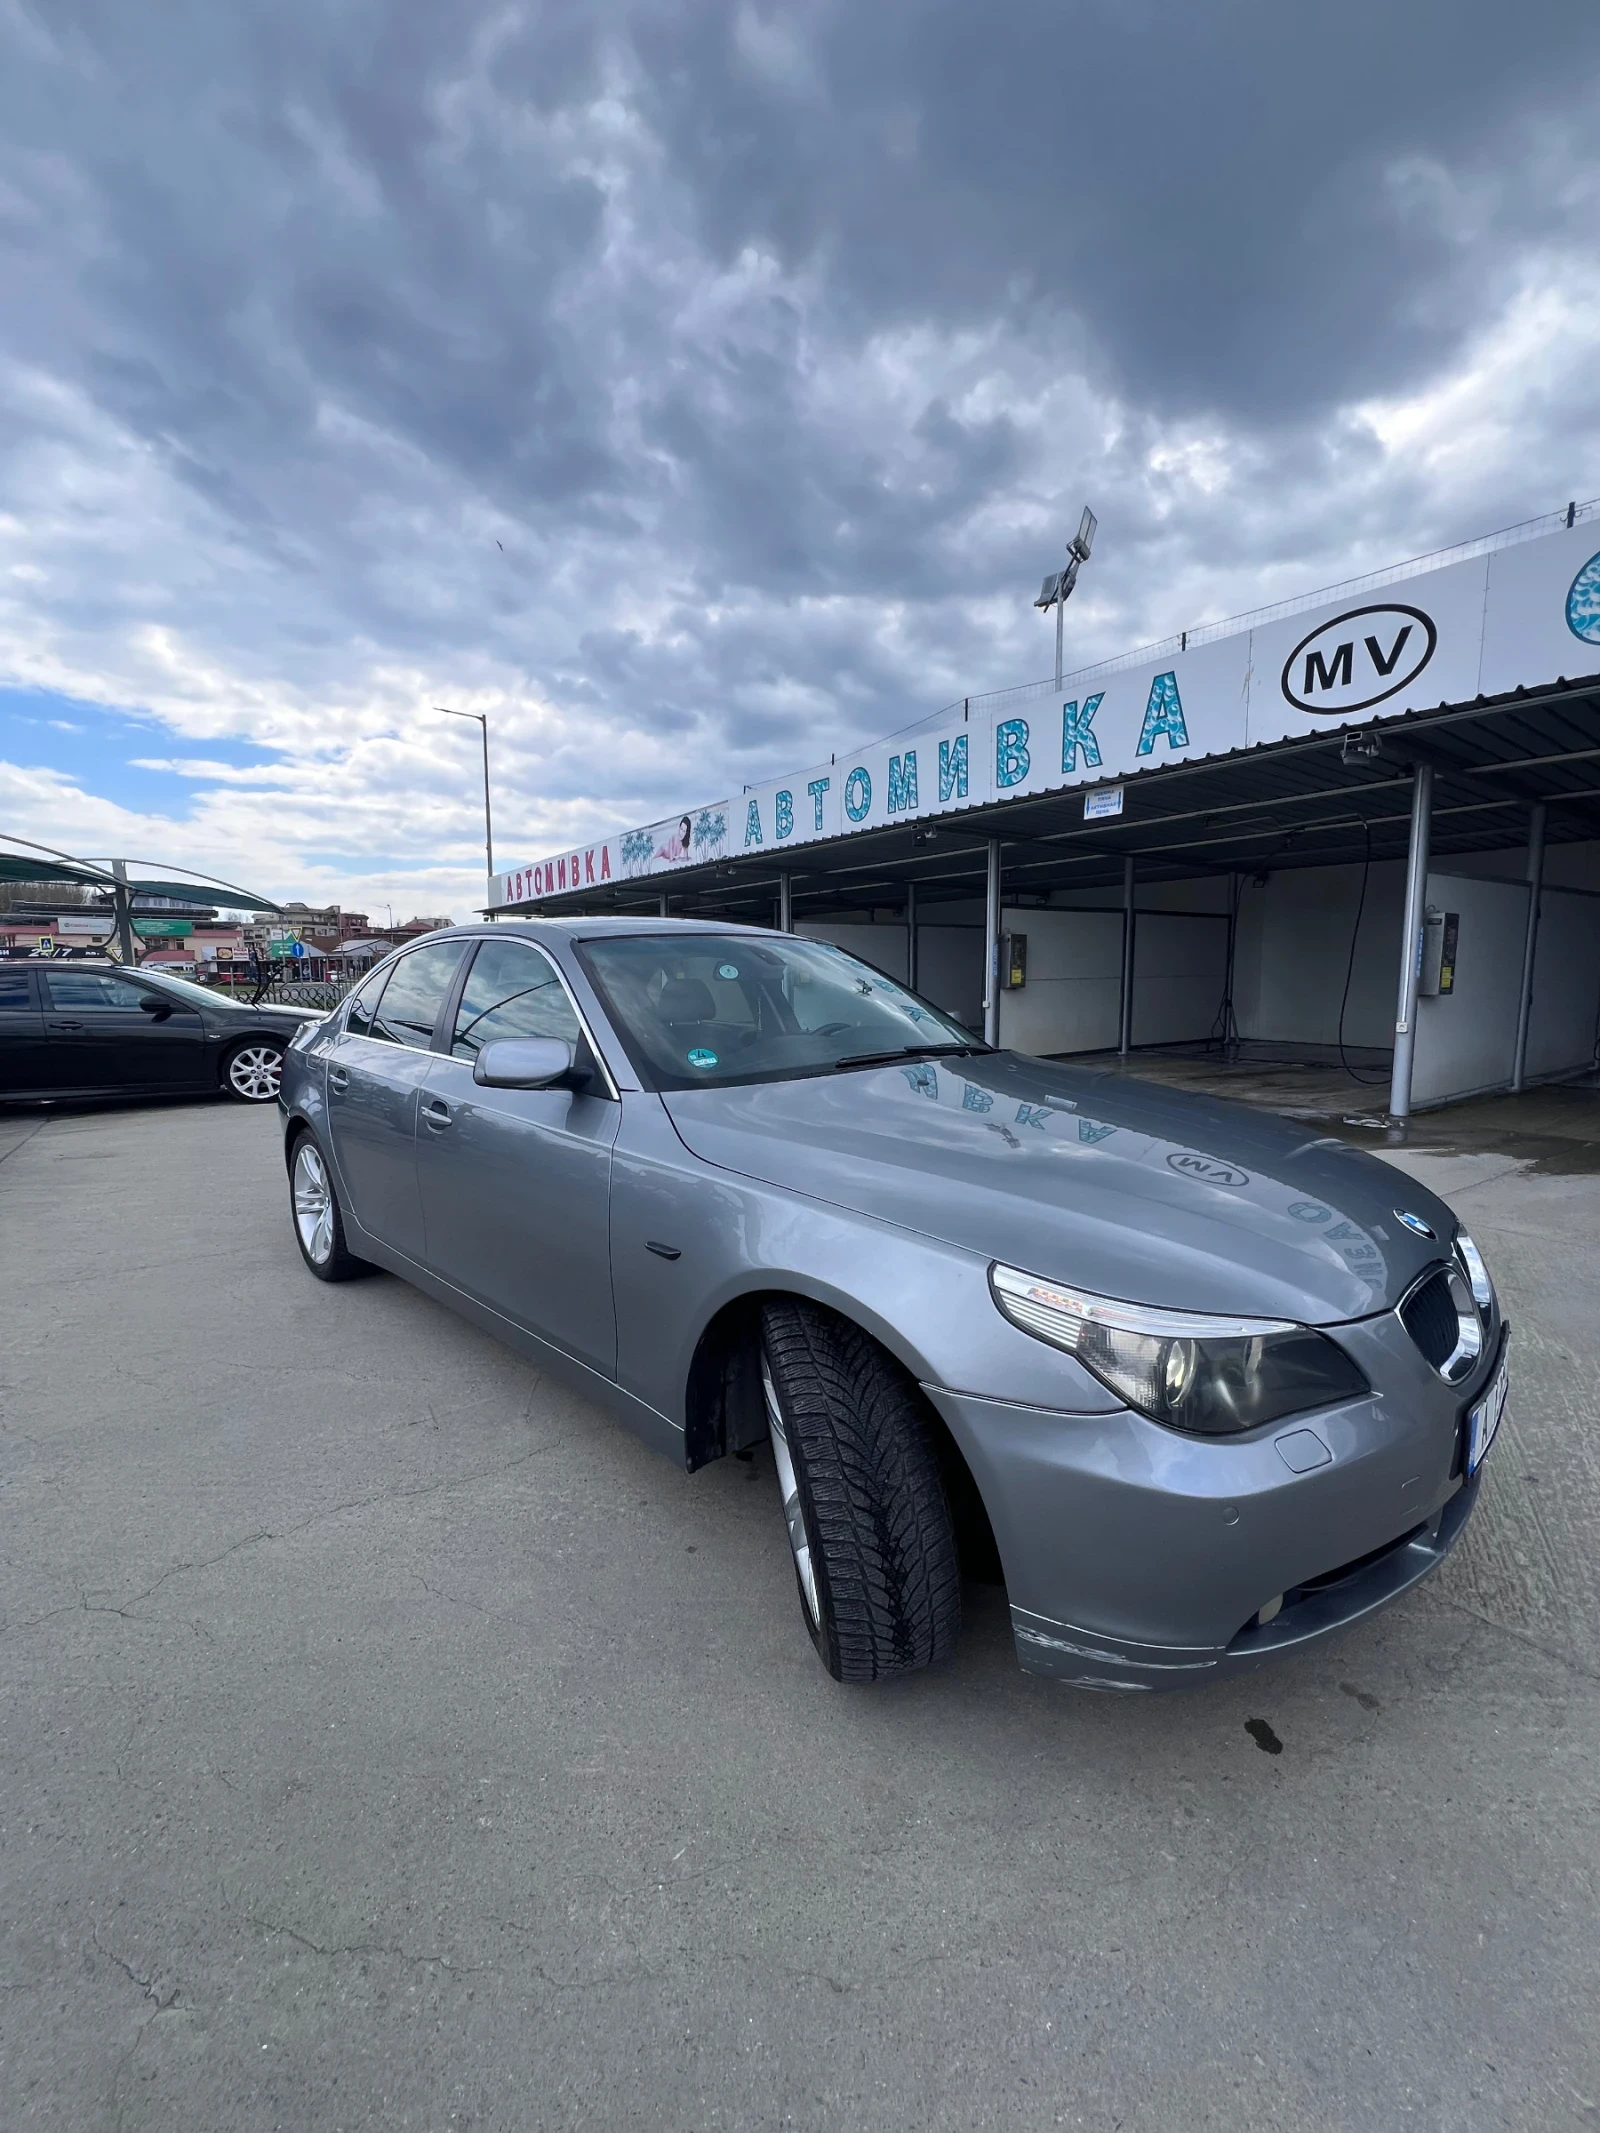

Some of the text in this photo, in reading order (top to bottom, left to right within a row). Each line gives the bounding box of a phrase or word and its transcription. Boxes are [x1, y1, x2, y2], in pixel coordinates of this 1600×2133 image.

[1304, 625, 1414, 695] MV
[744, 671, 1190, 848] АВТОМИВКА
[506, 845, 611, 902] АВТОМИВКА
